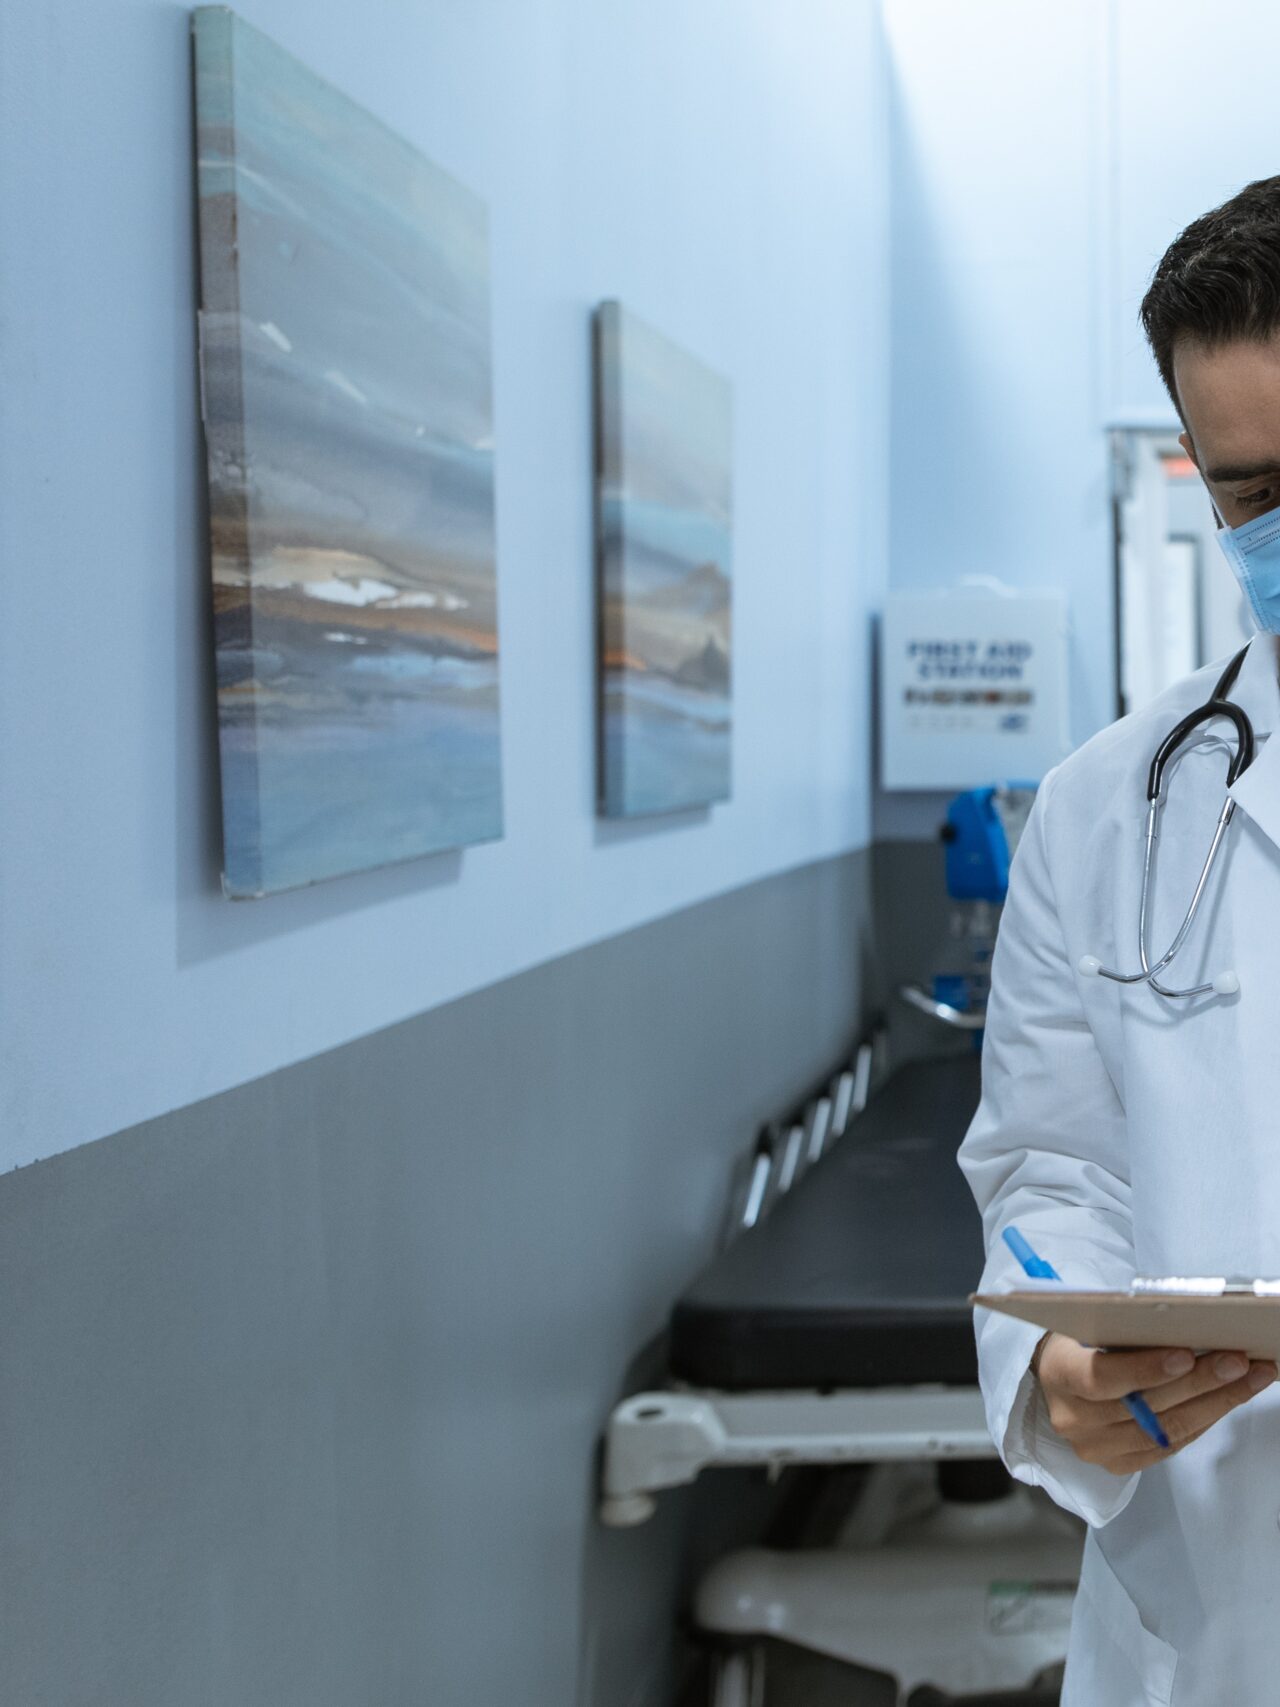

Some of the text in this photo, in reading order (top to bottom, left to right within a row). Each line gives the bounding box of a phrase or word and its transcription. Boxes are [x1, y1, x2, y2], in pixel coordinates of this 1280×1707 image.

[906, 639, 1033, 659] FIRST AID
[917, 662, 1023, 680] STATION
